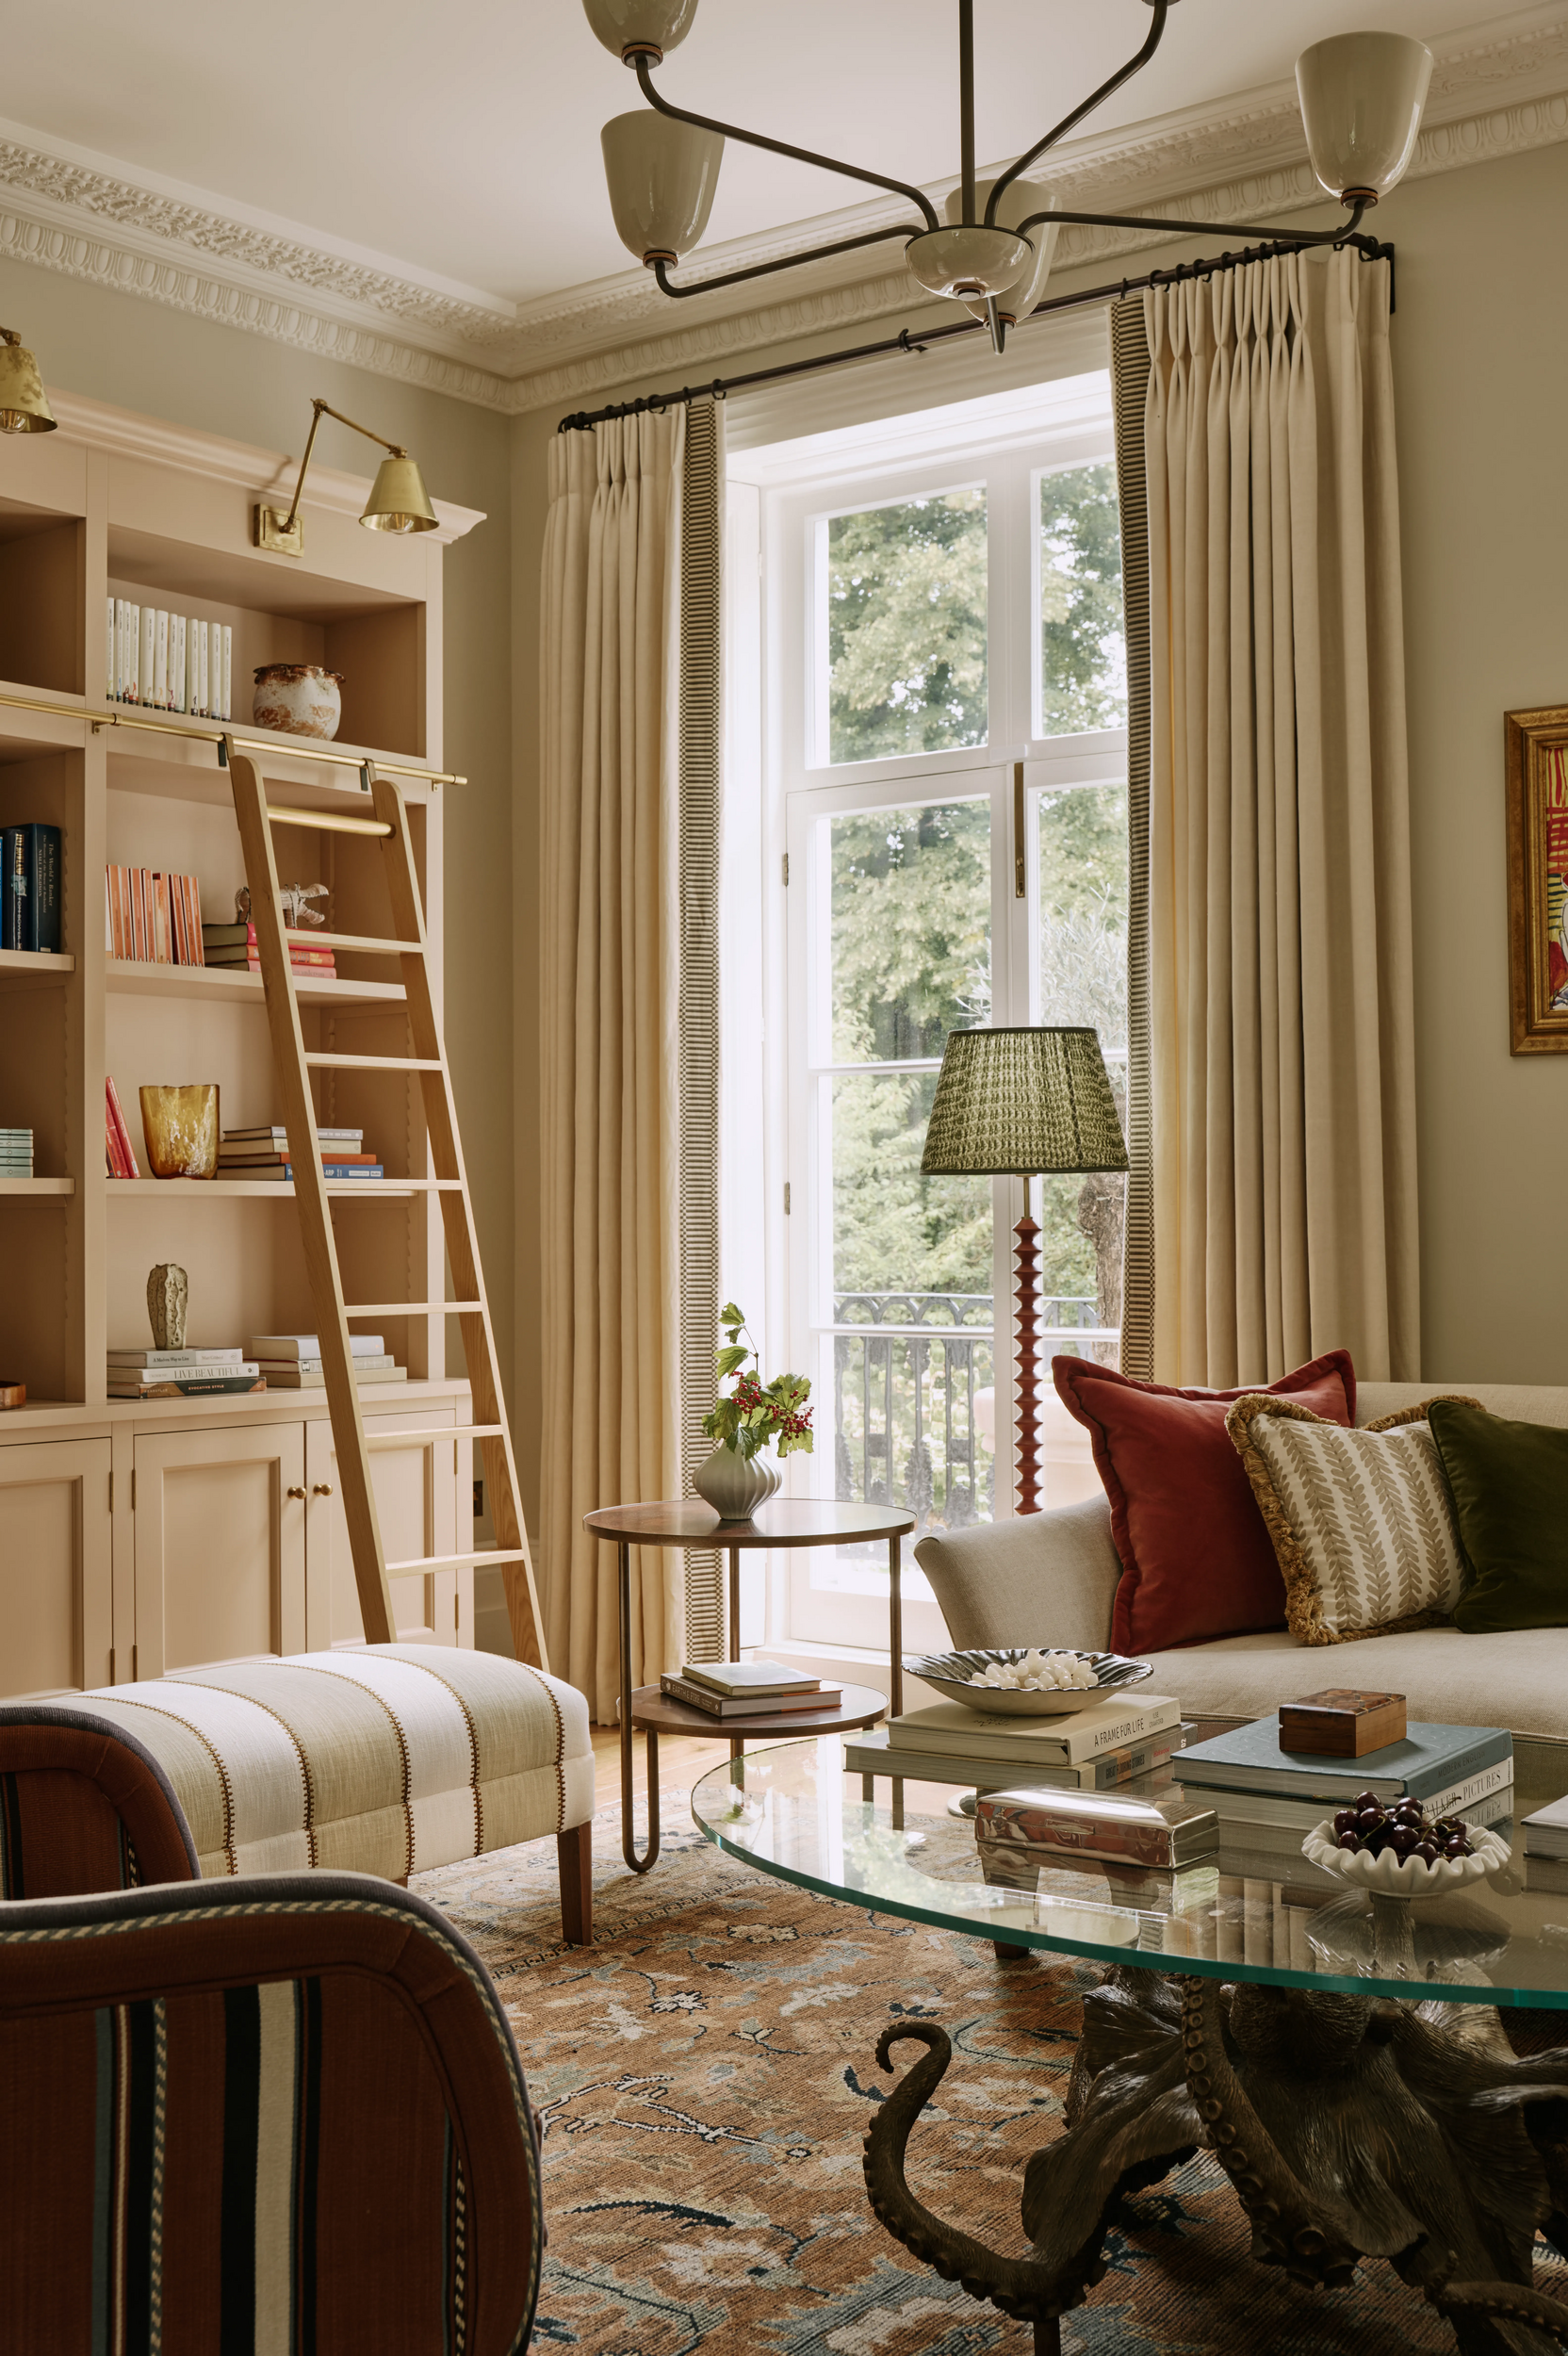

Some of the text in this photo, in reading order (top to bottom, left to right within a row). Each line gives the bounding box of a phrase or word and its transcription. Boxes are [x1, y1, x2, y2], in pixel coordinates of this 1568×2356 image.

[174, 1366, 241, 1379] LIVE BEAUTIFUL
[672, 1684, 687, 1696] EARTH
[690, 1692, 700, 1704] FIRE
[1094, 1717, 1144, 1747] A FRAME FOR LIFE
[1180, 1738, 1187, 1748] 02
[1105, 1753, 1145, 1780] GREAT FLOORING STORIES
[1437, 1760, 1462, 1779] MODERN
[1462, 1769, 1501, 1801] PICTURES
